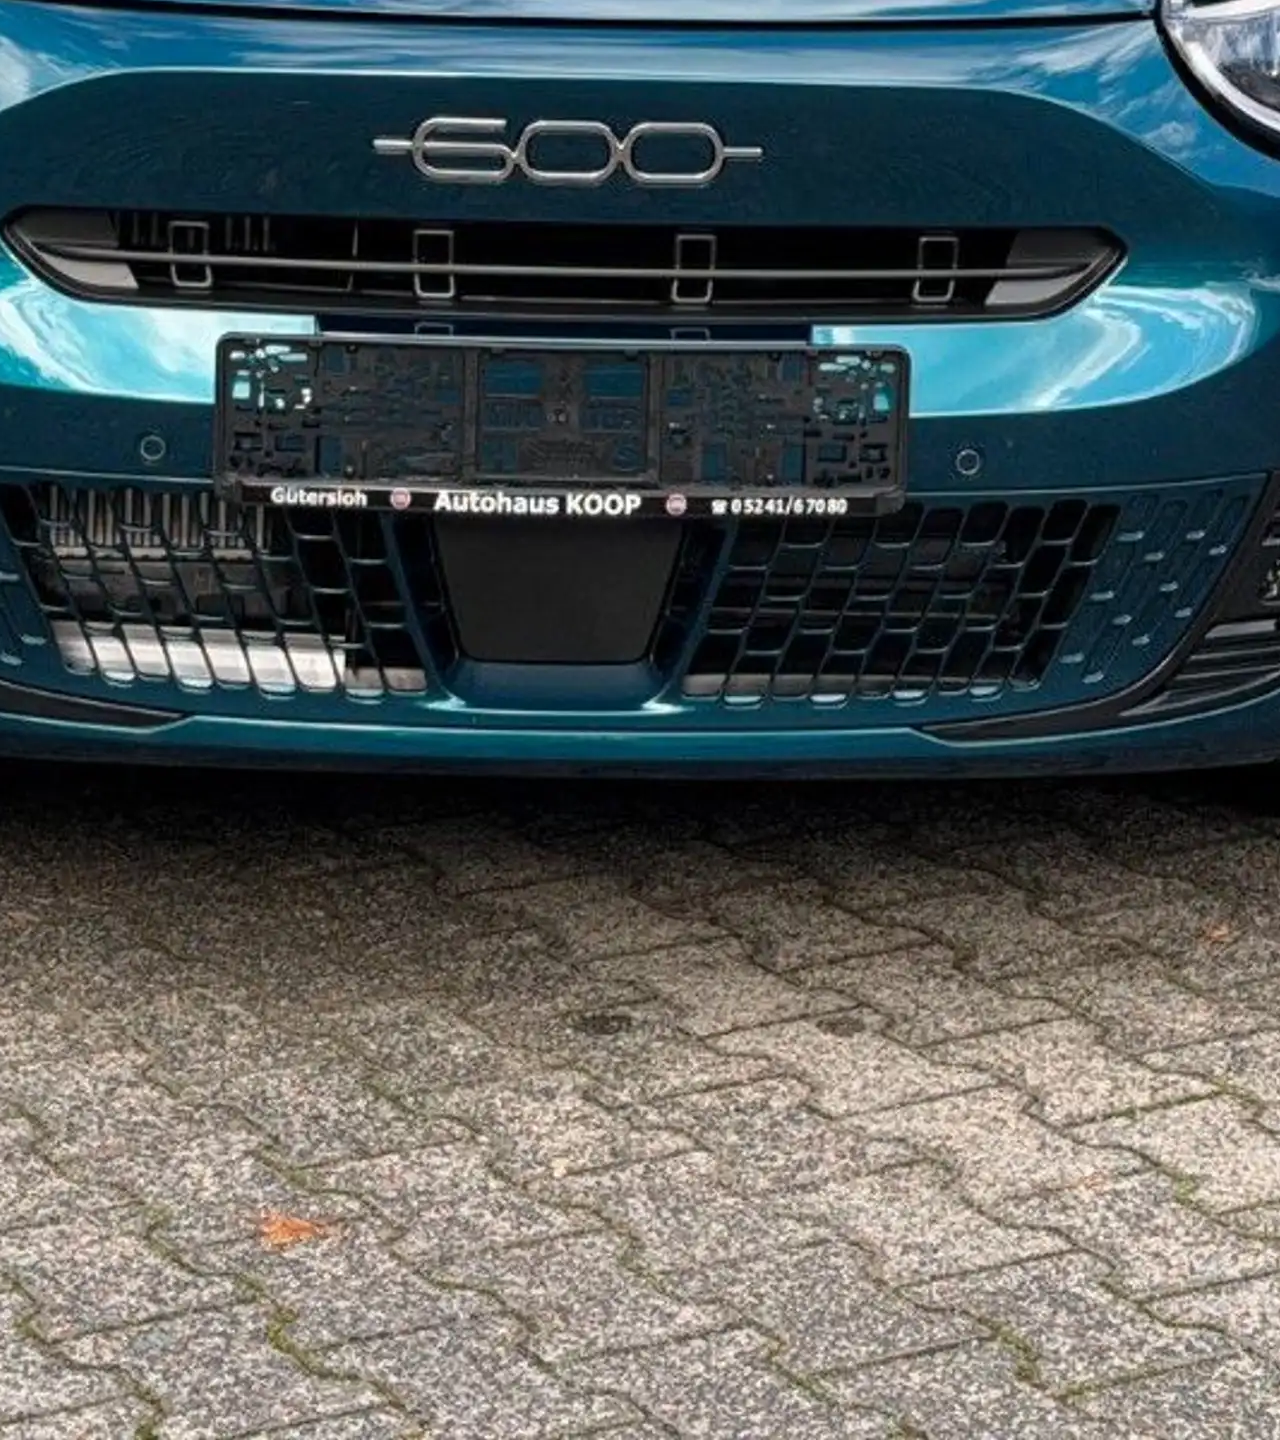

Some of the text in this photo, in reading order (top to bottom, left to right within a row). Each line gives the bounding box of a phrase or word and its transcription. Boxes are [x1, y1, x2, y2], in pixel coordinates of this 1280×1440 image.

[411, 116, 726, 186] 600
[271, 486, 368, 508] Gütersloh
[433, 490, 560, 515] Autohaus
[566, 493, 642, 516] KOOP
[731, 496, 848, 516] 05241/67080
